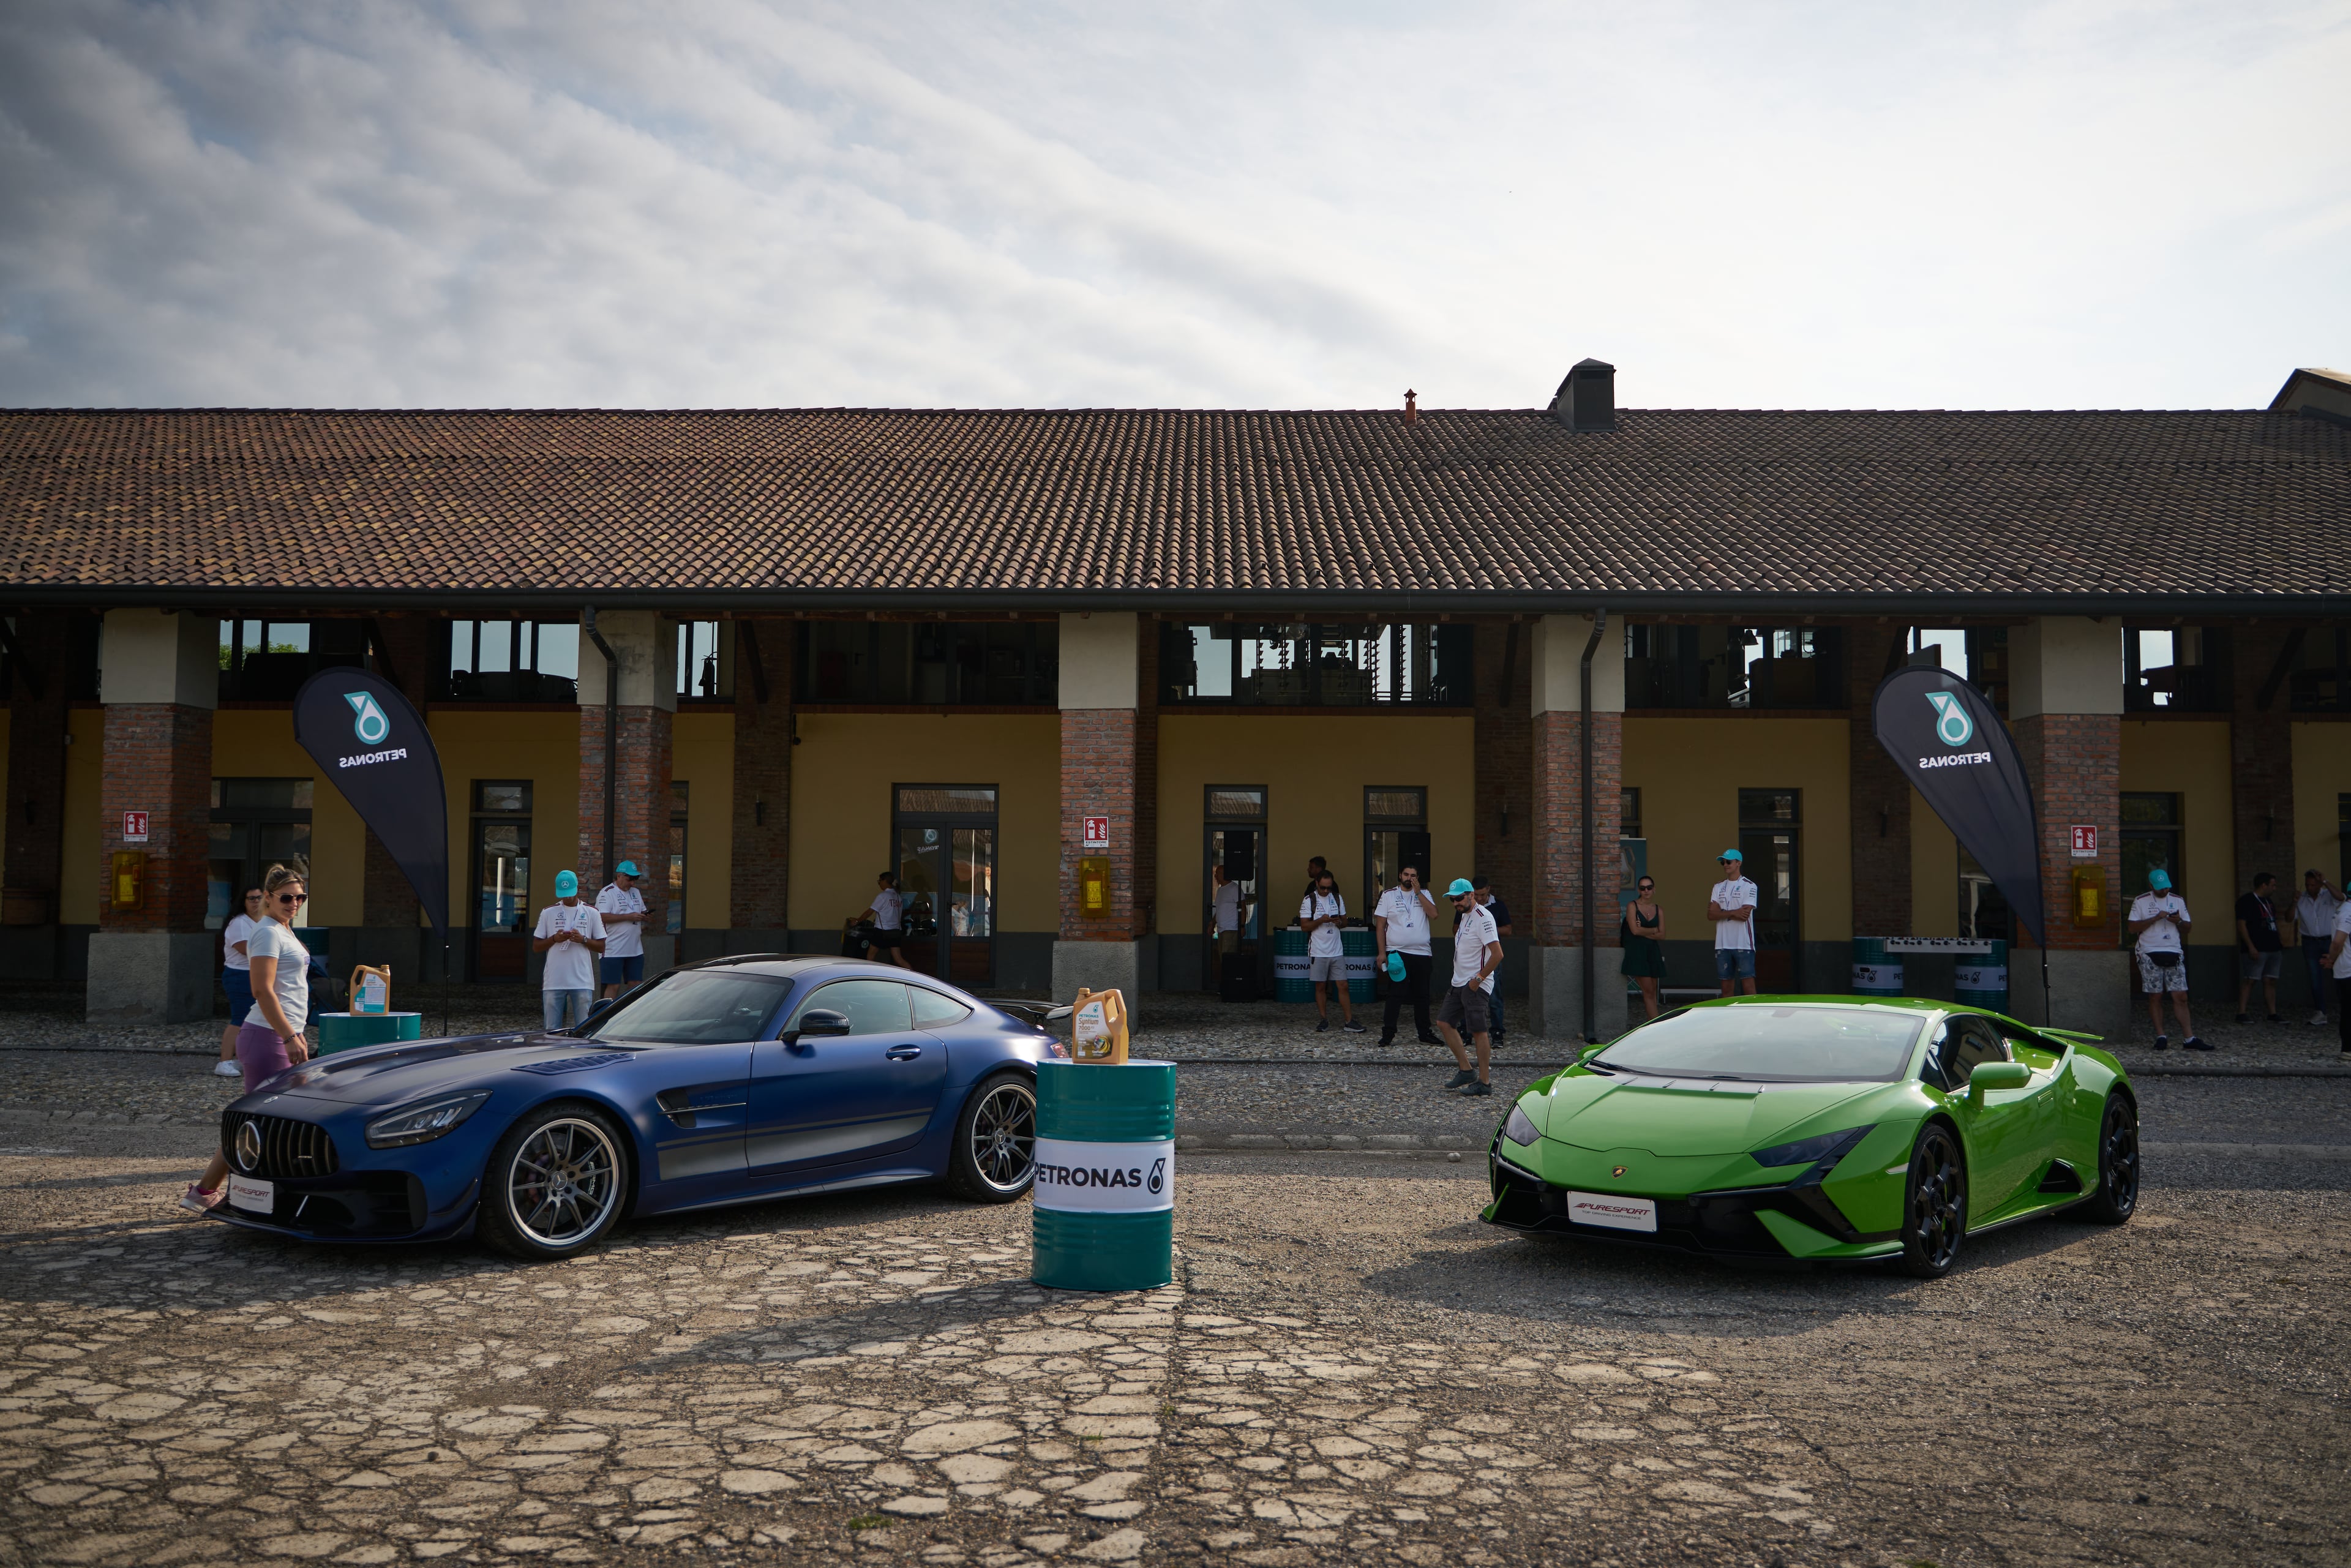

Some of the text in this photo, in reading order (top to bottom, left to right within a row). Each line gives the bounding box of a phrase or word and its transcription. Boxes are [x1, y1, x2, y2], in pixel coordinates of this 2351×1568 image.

[1035, 1161, 1142, 1187] PETRONAS
[234, 1185, 270, 1197] PURESPORT
[1583, 1203, 1651, 1215] PURESPORT
